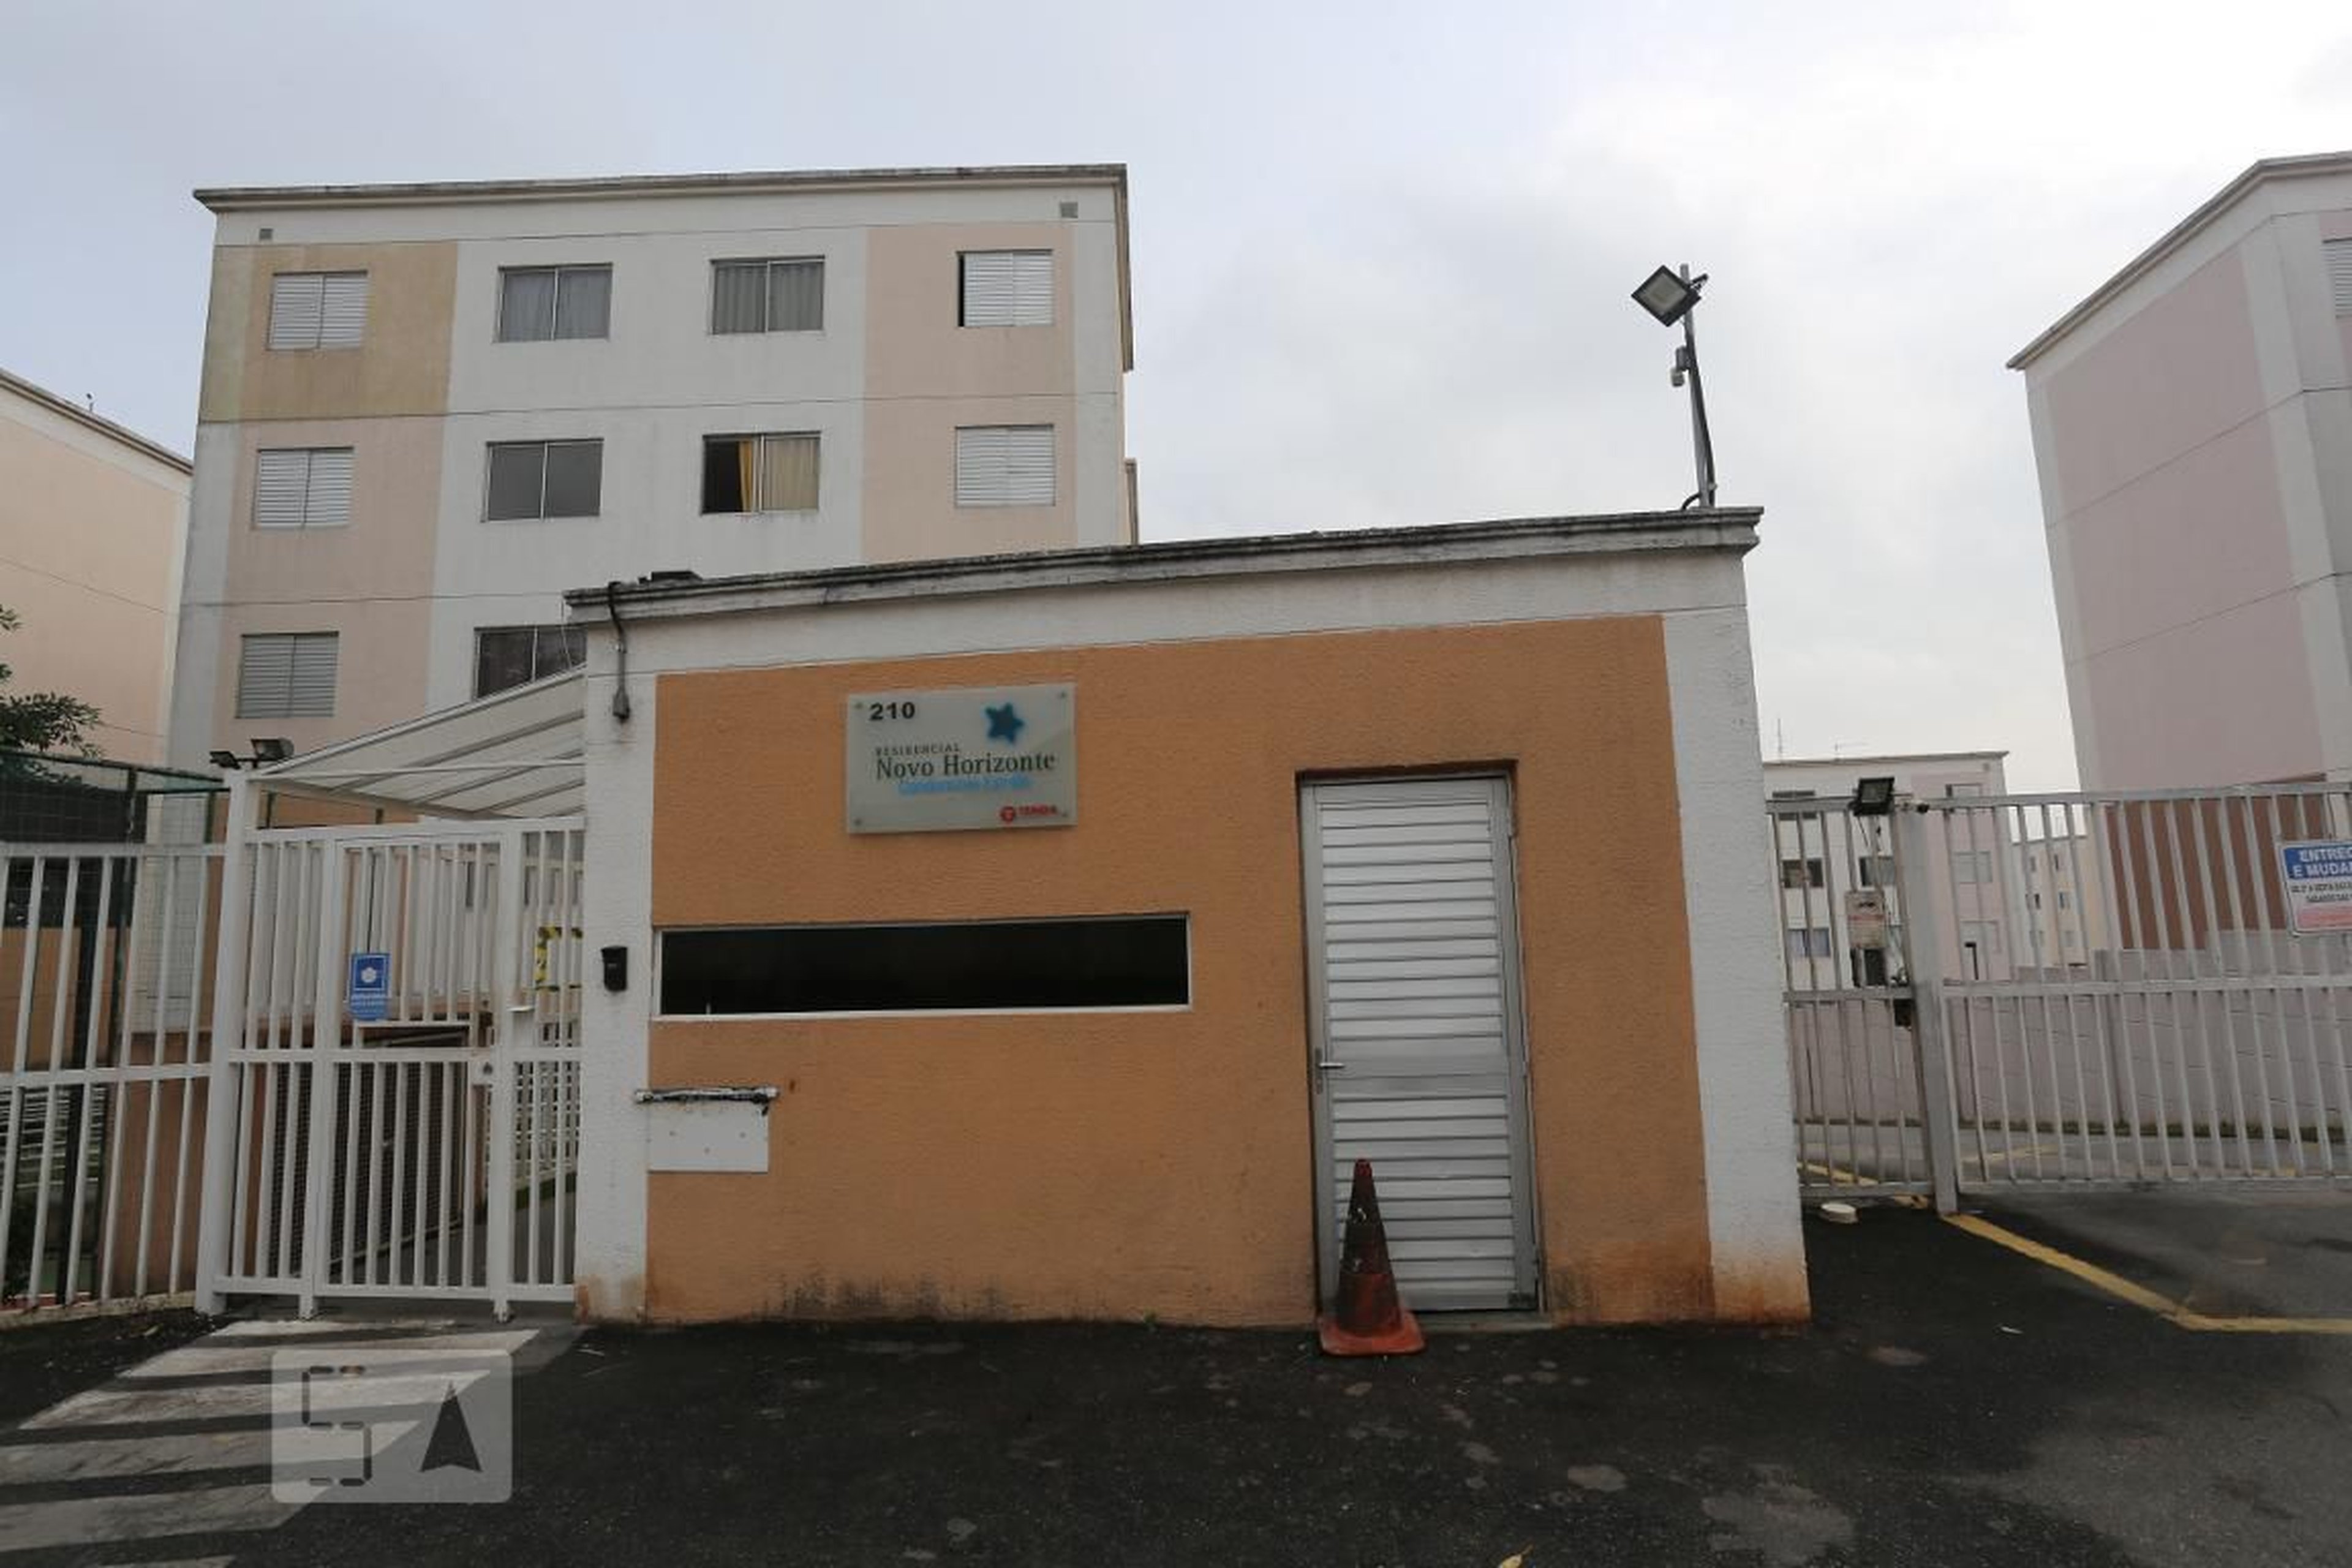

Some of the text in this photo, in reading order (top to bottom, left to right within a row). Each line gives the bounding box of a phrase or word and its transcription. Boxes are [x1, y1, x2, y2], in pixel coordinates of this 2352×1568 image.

[870, 702, 916, 720] 210
[876, 752, 1056, 780] Novo Horizonte
[2293, 865, 2302, 877] E
